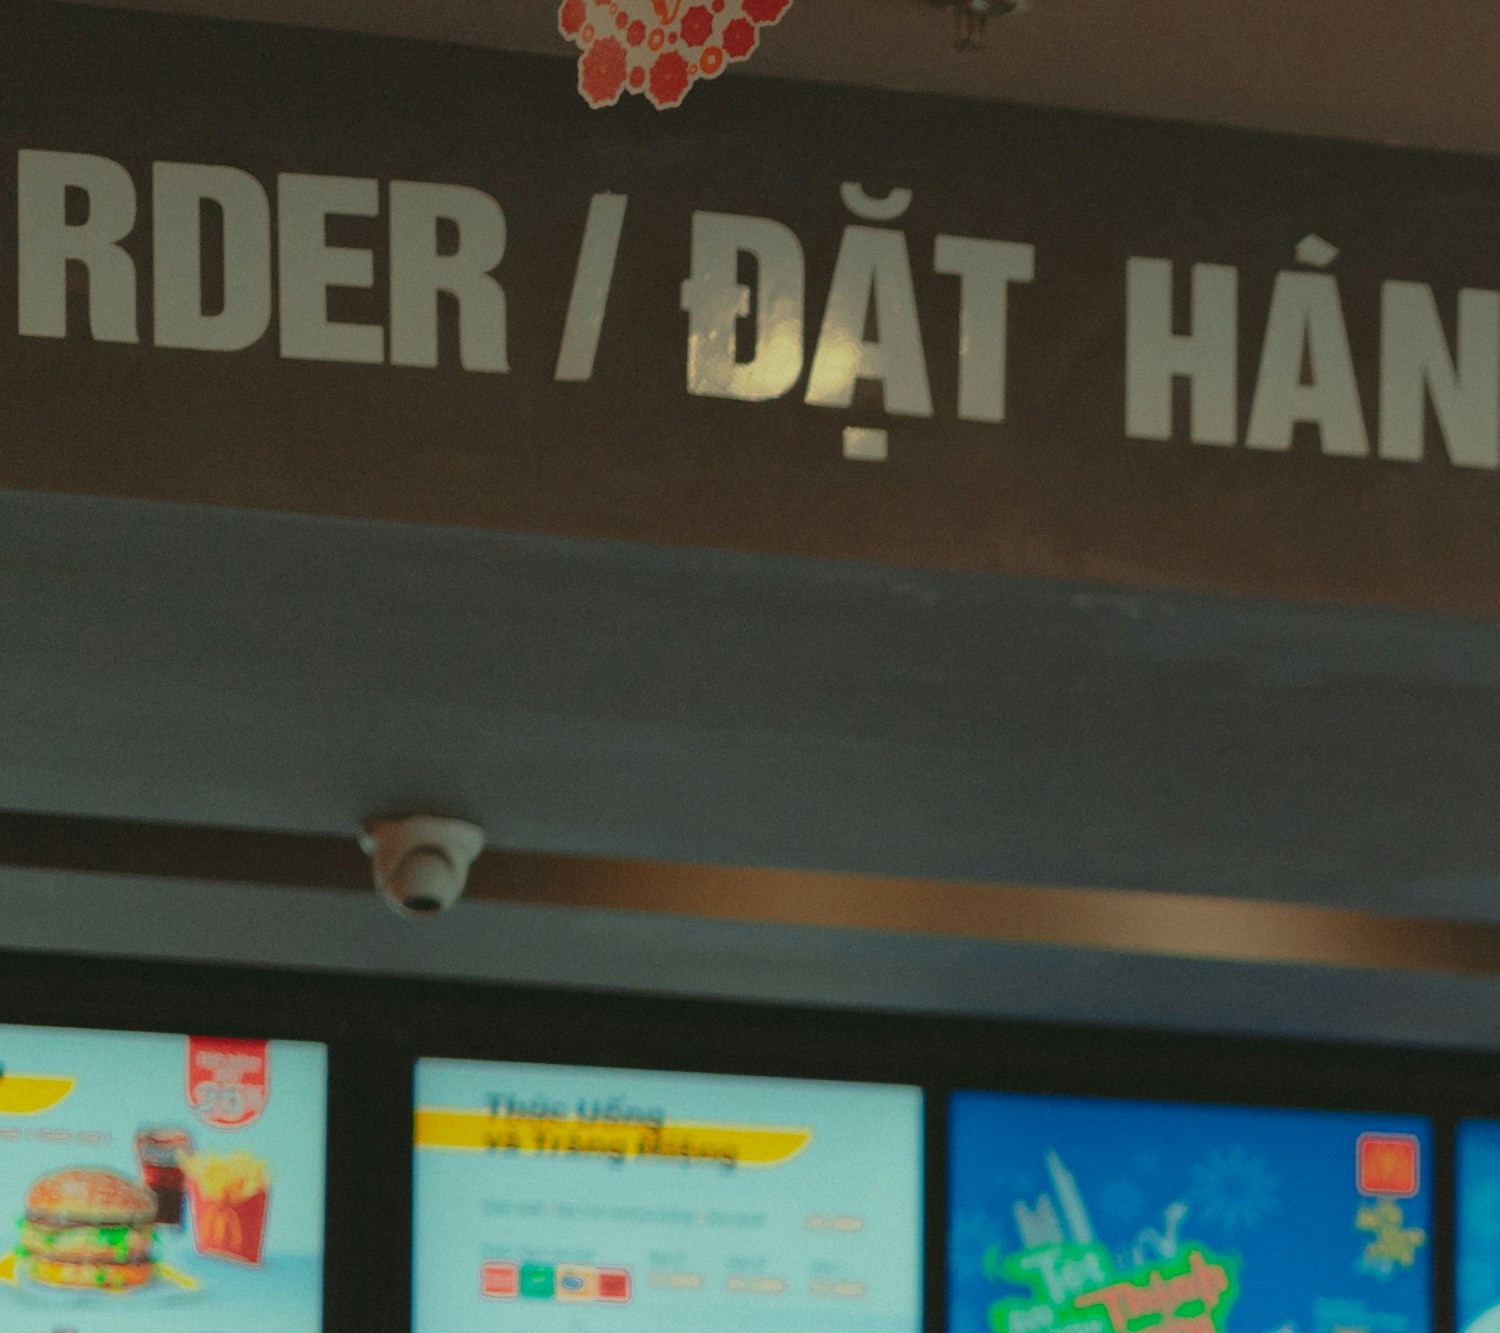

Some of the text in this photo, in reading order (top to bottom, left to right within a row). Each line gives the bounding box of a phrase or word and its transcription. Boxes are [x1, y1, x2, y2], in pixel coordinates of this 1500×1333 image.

[15, 146, 511, 373] RDER
[554, 190, 628, 384] /
[681, 182, 1036, 463] ĐẶT
